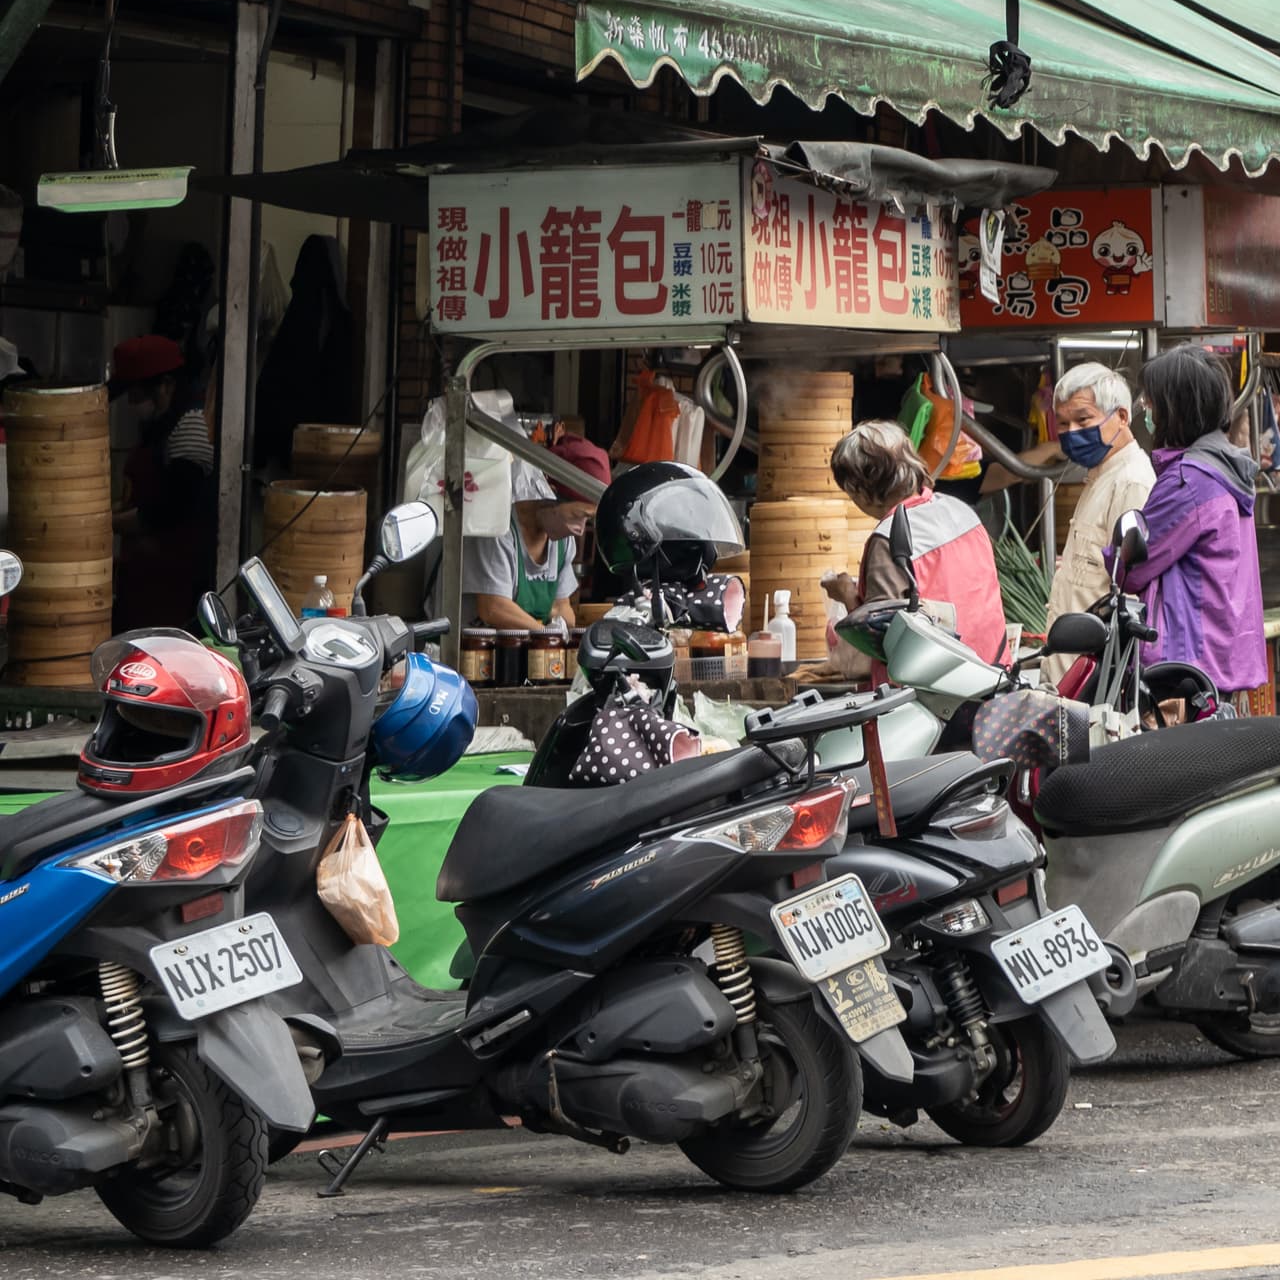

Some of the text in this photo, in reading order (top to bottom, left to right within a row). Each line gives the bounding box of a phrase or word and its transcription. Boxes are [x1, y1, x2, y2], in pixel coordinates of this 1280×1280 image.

[436, 206, 468, 321] 現做祖傳
[473, 204, 669, 321] 小籠包
[672, 241, 733, 277] 豆漿 10元
[796, 193, 909, 315] 小籠包
[911, 244, 932, 279] 豆漿
[671, 281, 734, 317] 米漿 10元
[911, 285, 932, 319] 米漿
